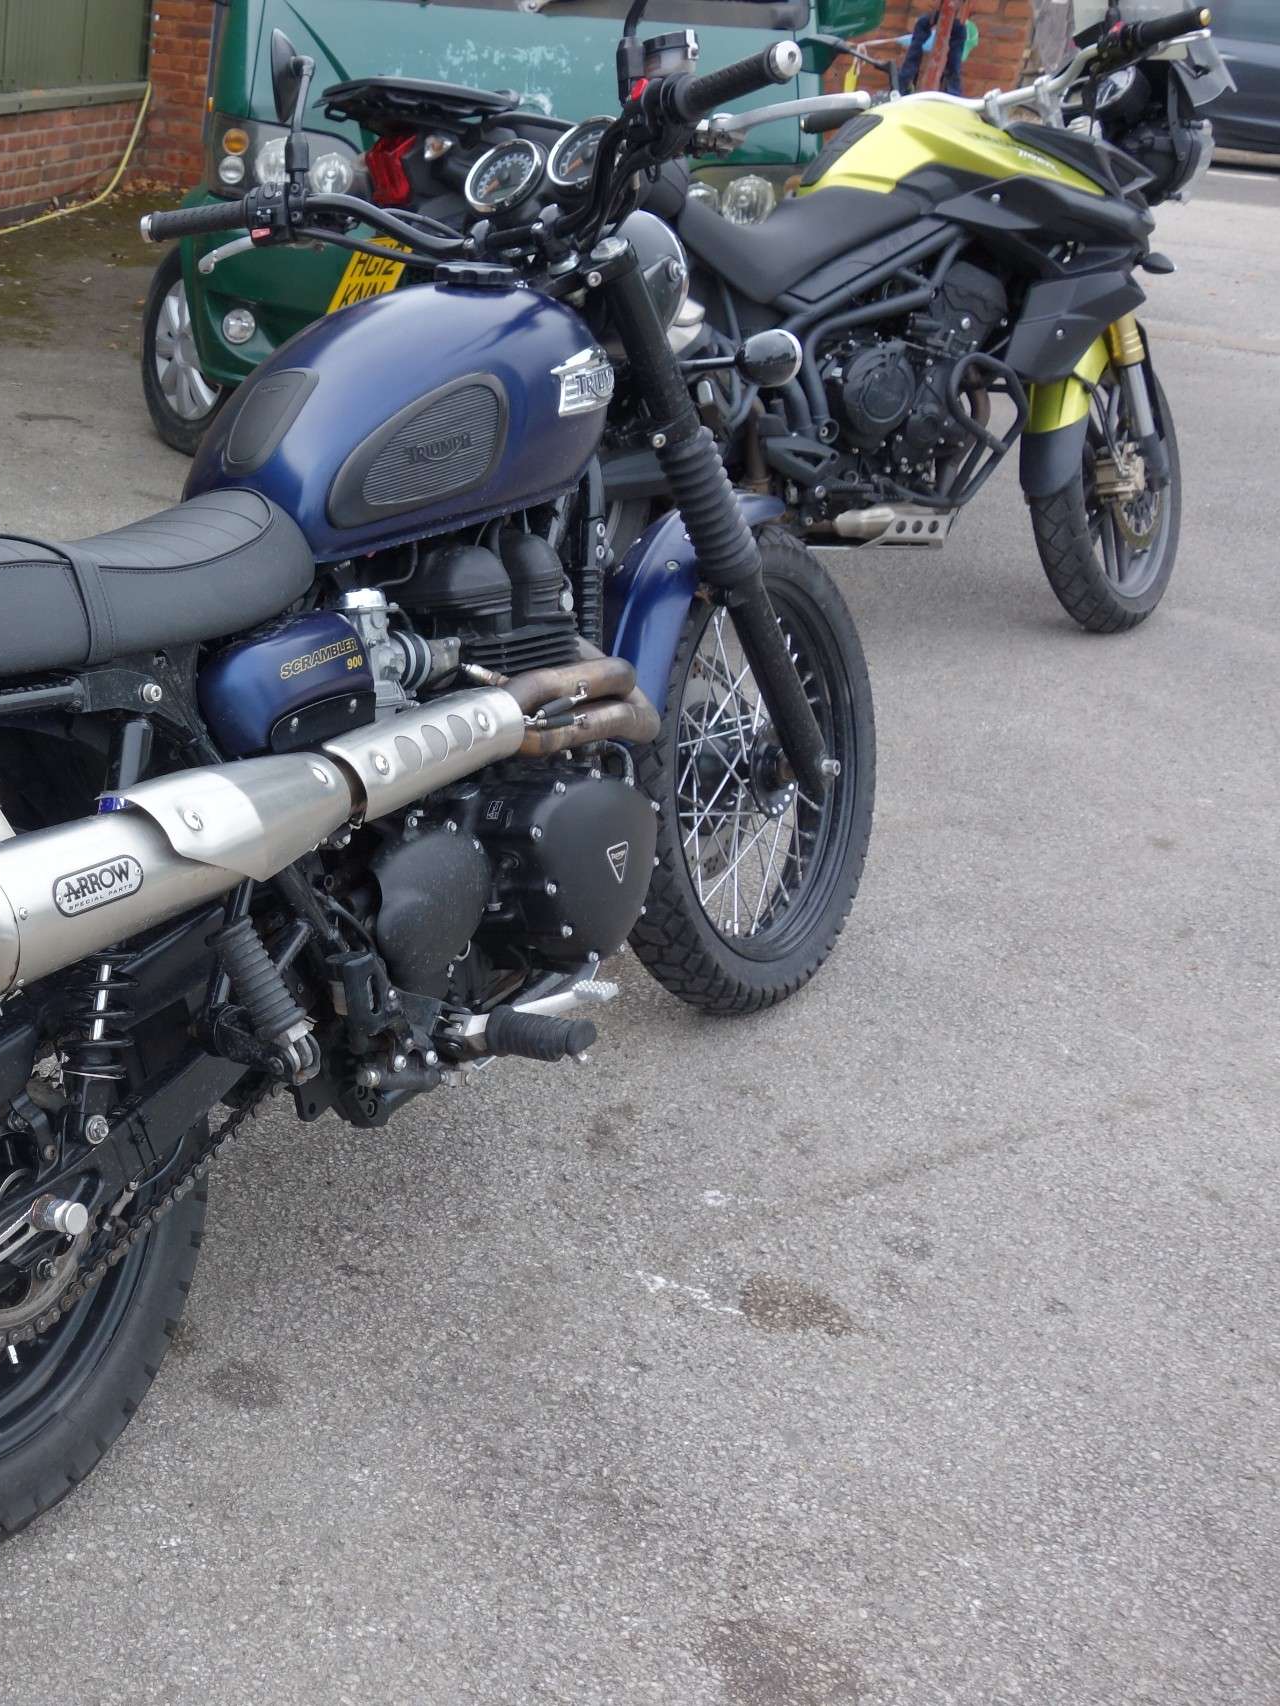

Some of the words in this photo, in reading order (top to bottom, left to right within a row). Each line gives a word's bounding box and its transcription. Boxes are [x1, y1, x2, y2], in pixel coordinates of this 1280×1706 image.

[404, 431, 471, 464] TRIUMPH
[280, 637, 359, 680] SCRAMBLER
[346, 655, 363, 670] 900
[64, 860, 130, 903] ARROW
[69, 895, 105, 911] SPECIAL
[108, 883, 133, 896] PARTS
